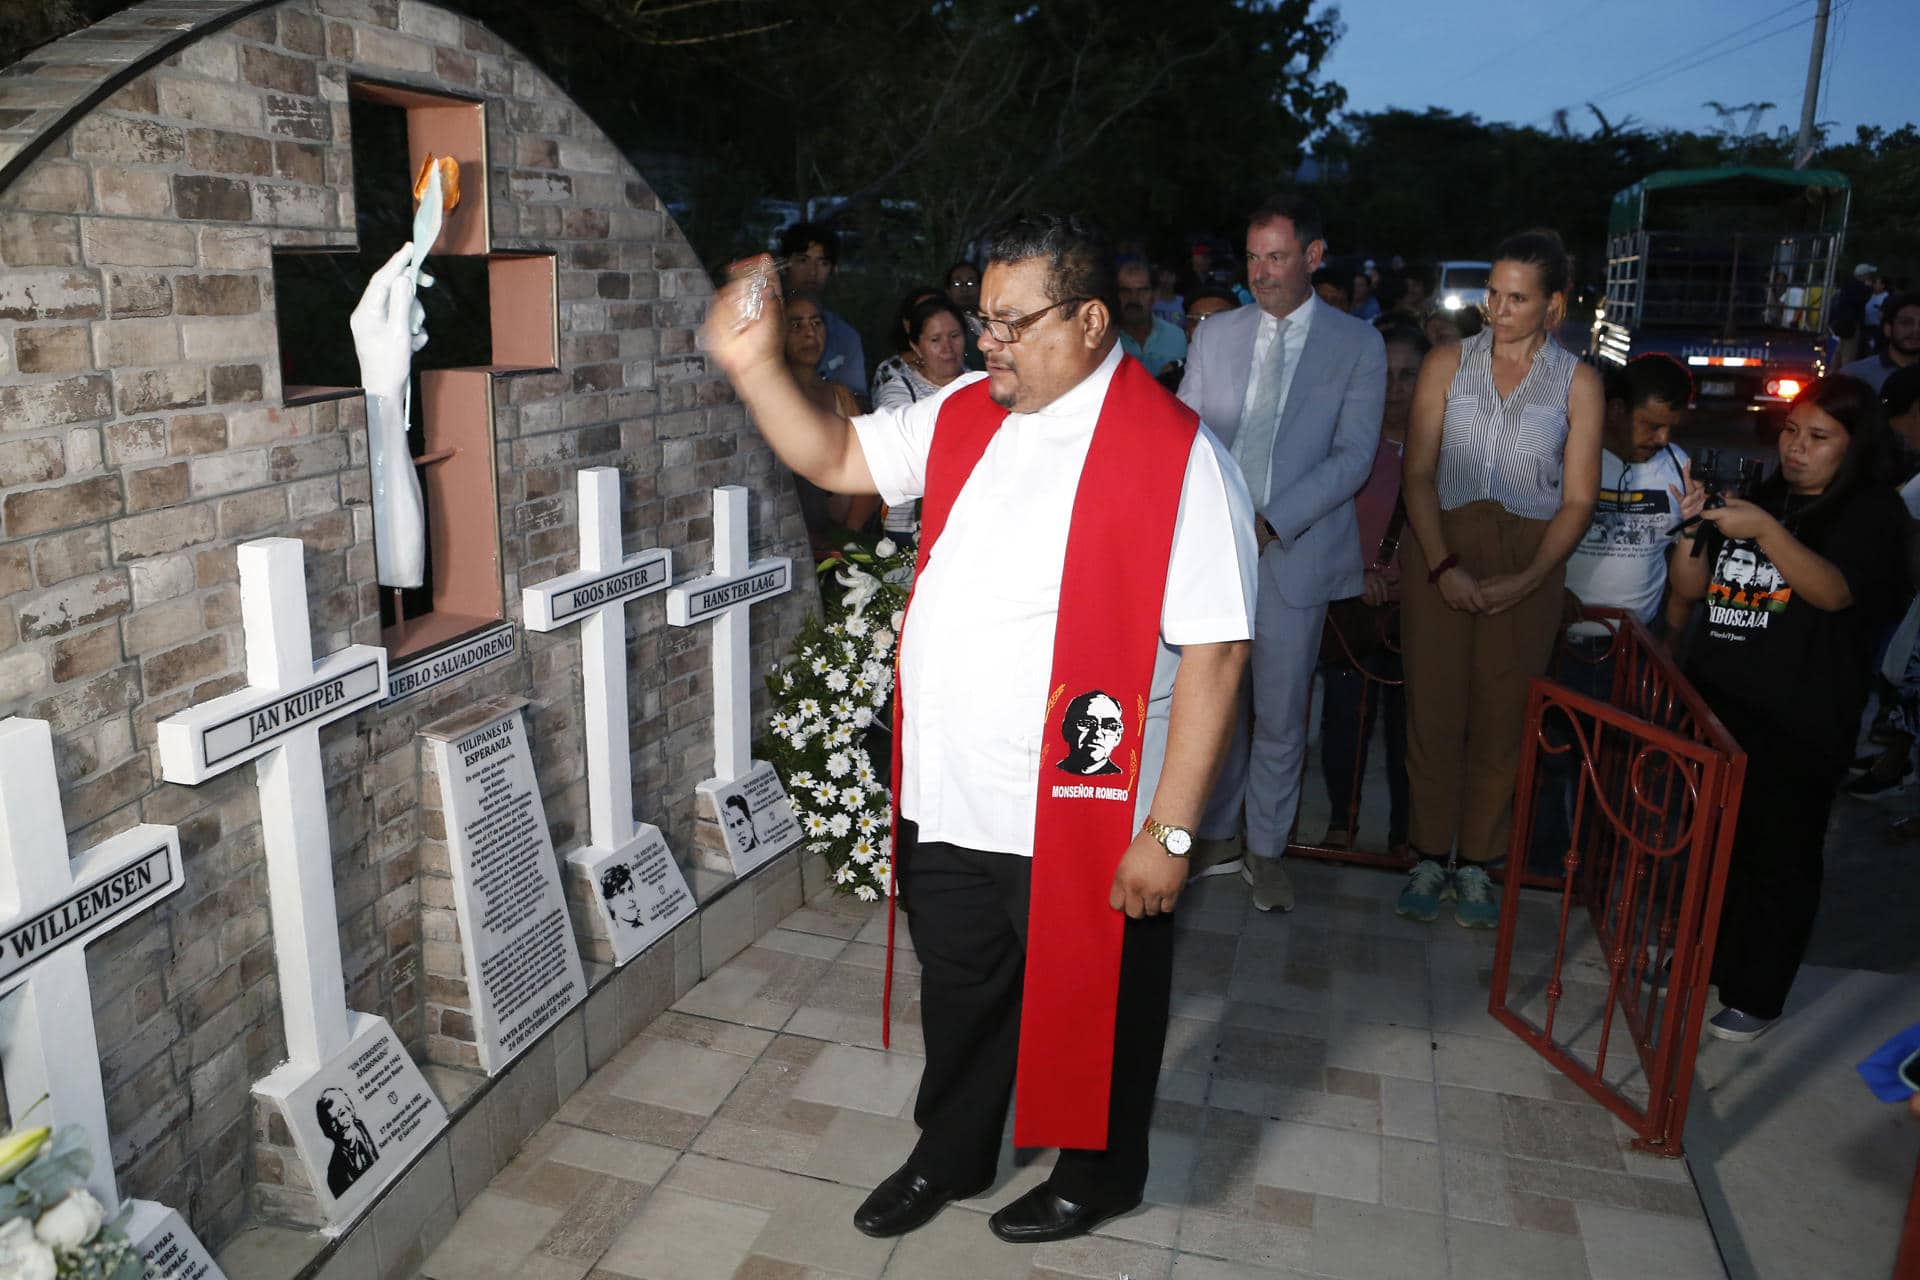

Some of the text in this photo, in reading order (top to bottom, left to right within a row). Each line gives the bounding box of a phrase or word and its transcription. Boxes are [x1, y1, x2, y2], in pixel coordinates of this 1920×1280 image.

[573, 569, 649, 609] KOOS KOSTER
[703, 573, 775, 609] HANS TER LAAG
[388, 633, 512, 697] UEBLO SALVADOREÑO
[248, 680, 346, 743] JAN KUIPER
[457, 719, 513, 753] TULIPANES DE
[465, 736, 511, 766] ESPERANZA
[1052, 783, 1129, 802] MONSEÑOR ROMERO
[10, 861, 153, 959] WILLEMSEN
[154, 1232, 174, 1253] PARA
[181, 1261, 196, 1279] 1957
